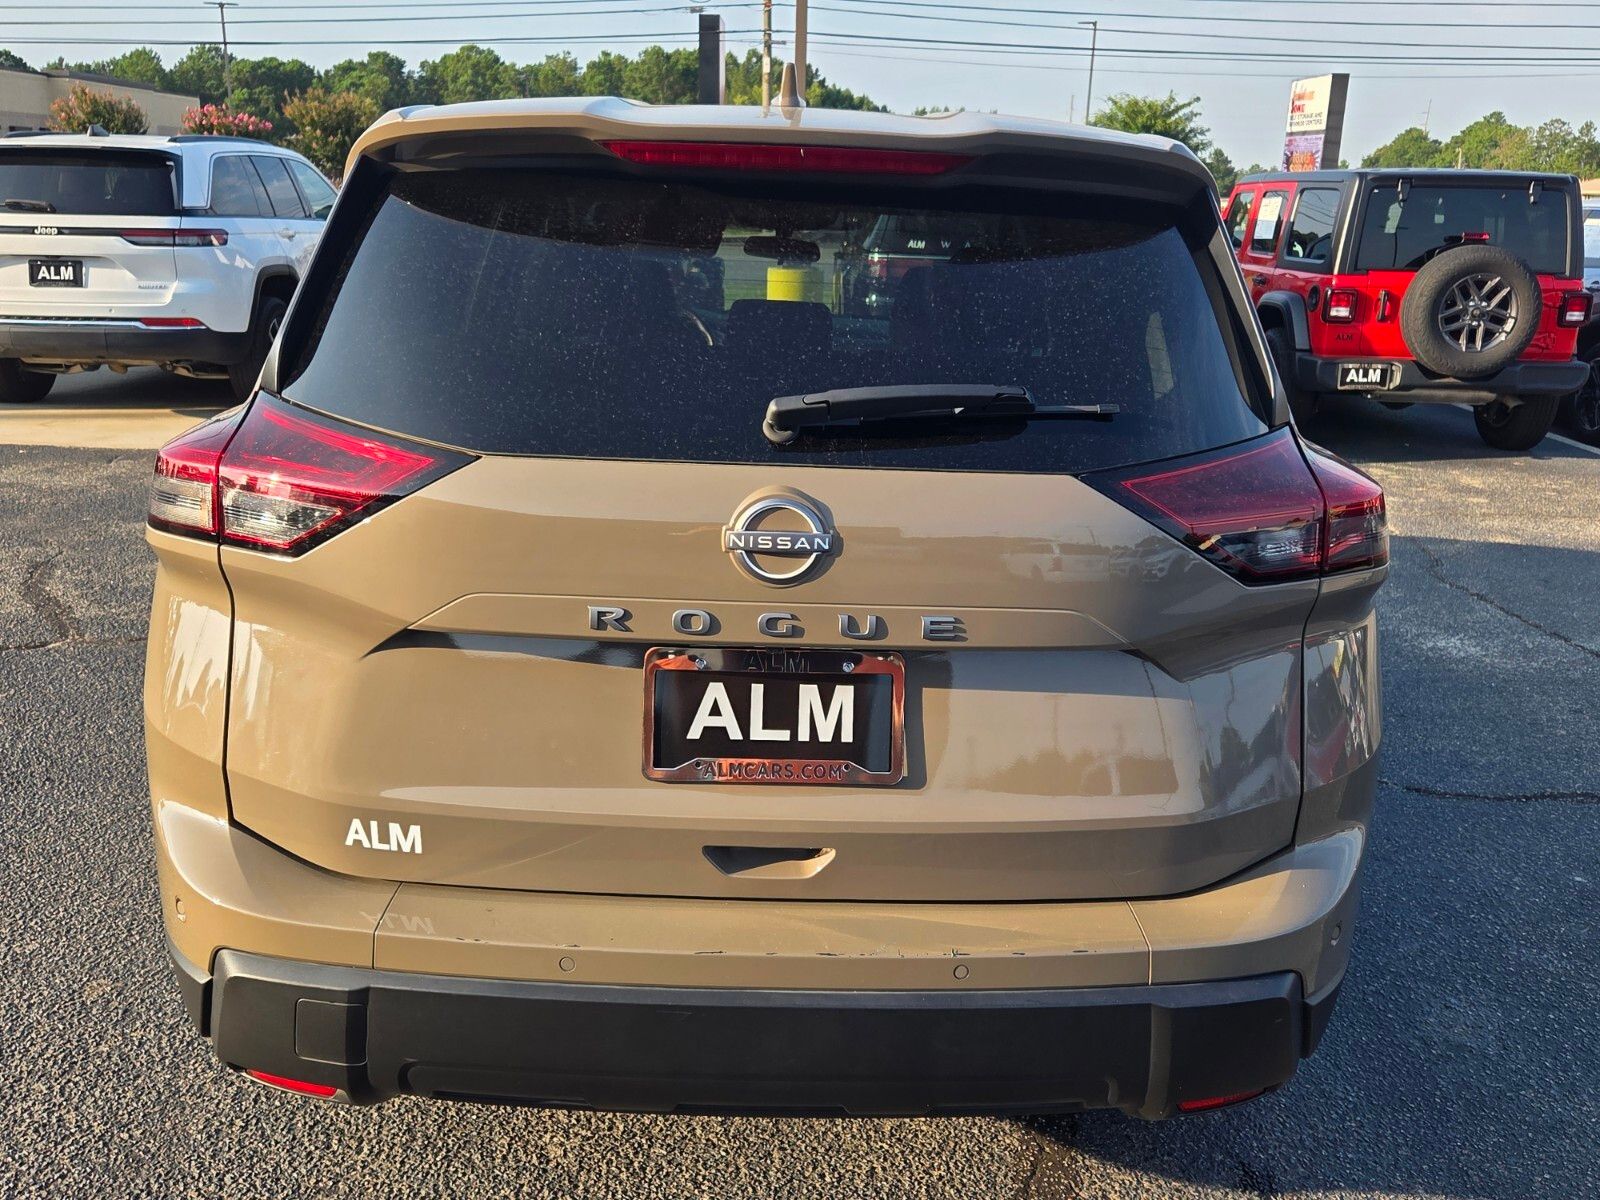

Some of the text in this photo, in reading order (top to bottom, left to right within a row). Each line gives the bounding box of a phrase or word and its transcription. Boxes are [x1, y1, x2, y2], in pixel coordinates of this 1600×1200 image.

[34, 225, 58, 236] Jeep
[37, 265, 74, 280] ALM
[1345, 368, 1381, 383] ALM
[728, 533, 831, 551] NISSAN
[587, 605, 962, 641] ROGUE
[686, 681, 855, 743] ALM
[702, 760, 844, 780] ALMCARS.COM
[344, 818, 423, 854] ALM
